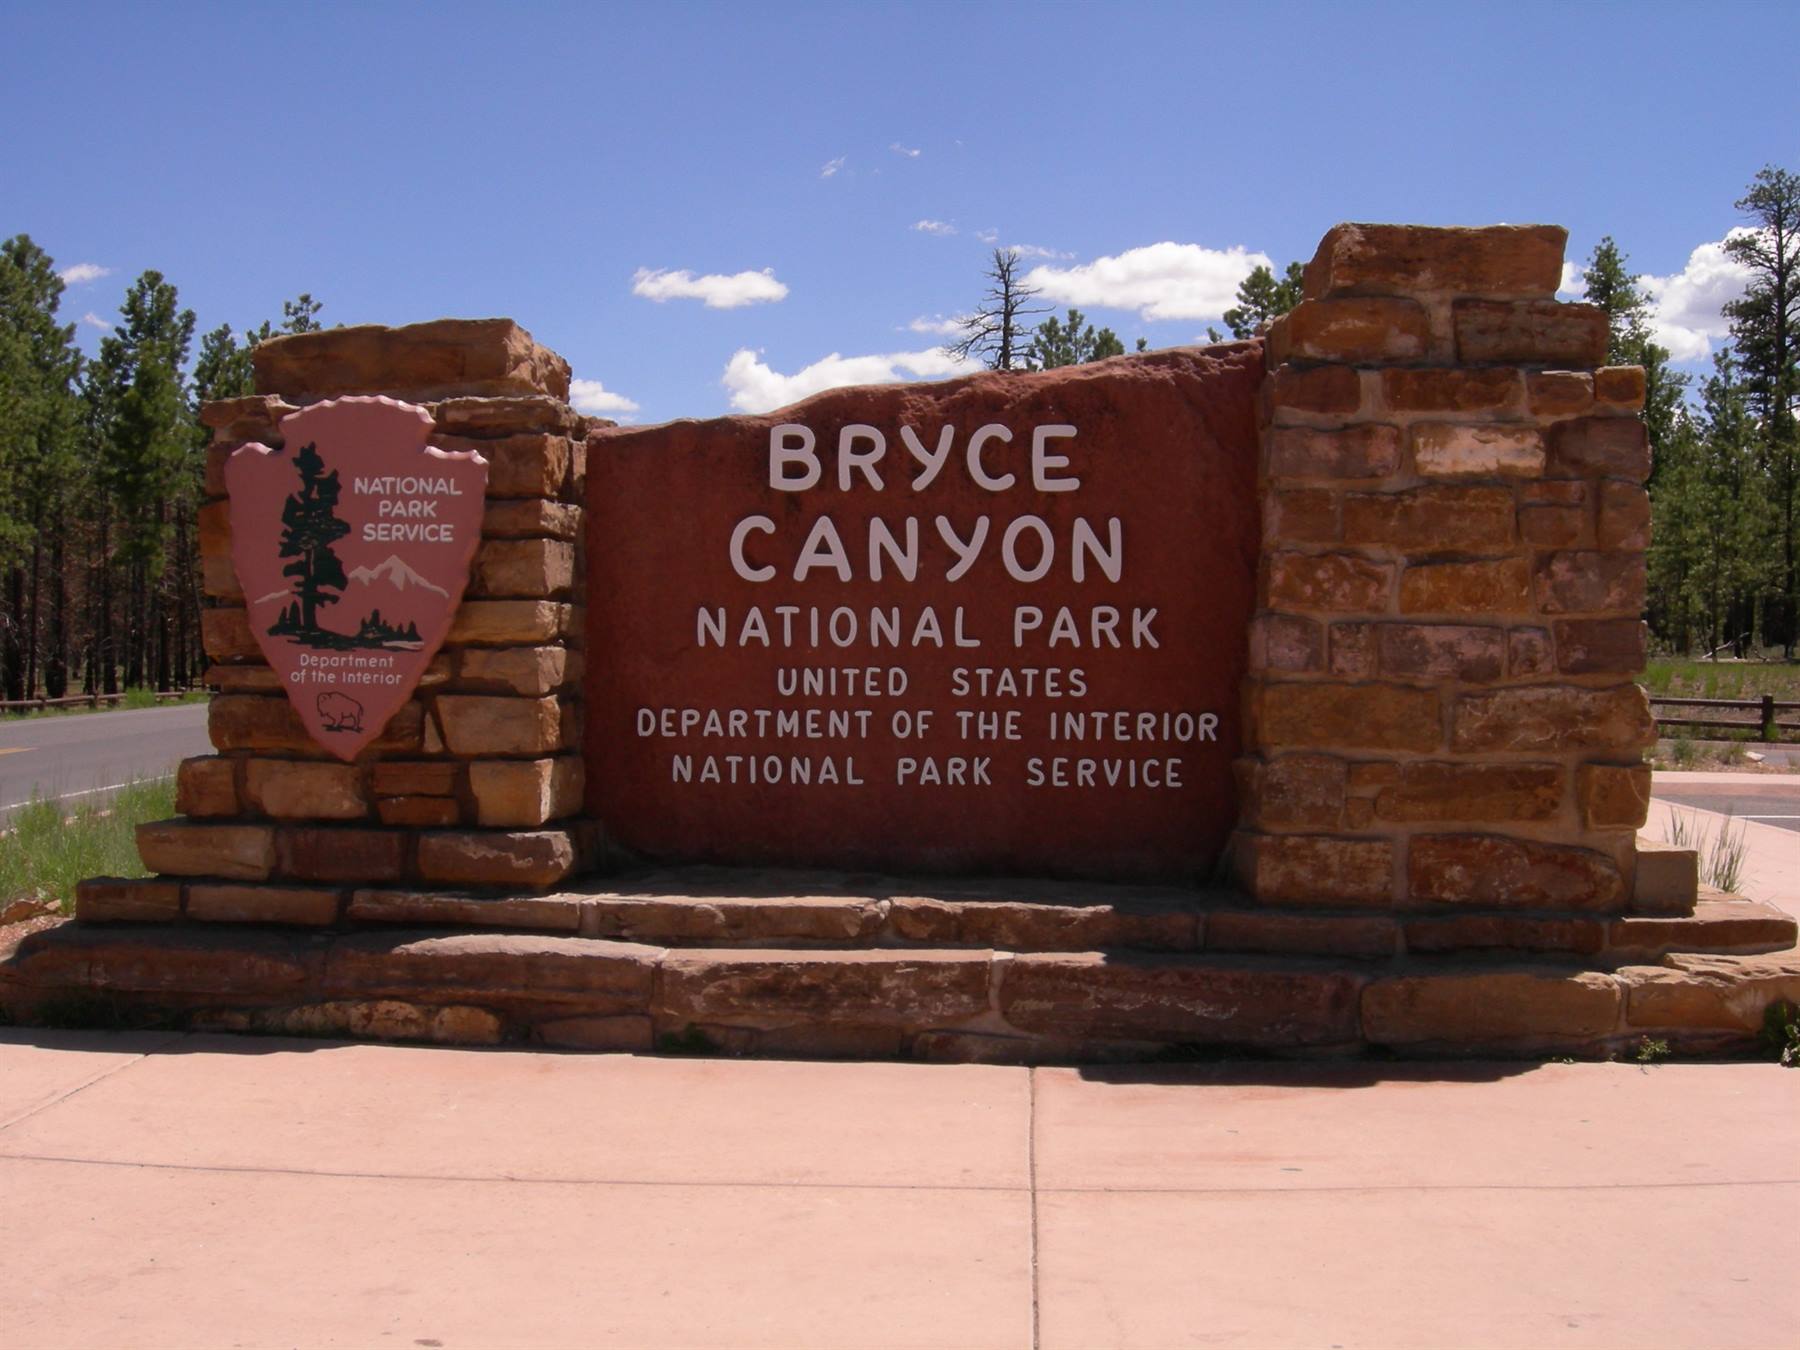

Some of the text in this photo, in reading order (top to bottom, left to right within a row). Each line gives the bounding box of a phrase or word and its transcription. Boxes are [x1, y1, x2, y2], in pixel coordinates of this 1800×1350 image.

[768, 423, 1080, 491] BRYCE
[355, 477, 462, 495] NATIONAL
[379, 500, 437, 517] PARK
[363, 523, 454, 542] SERVICE
[730, 515, 1121, 583] CANYON
[698, 606, 1159, 648] NATIONAL PARK
[300, 653, 394, 668] Department
[290, 669, 403, 685] of the Interior
[778, 667, 1086, 697] UNITED STATES
[638, 709, 1218, 741] DEPARTMENT OF THE INTERIOR
[673, 755, 1182, 787] NATIONAL PARK SERVICE
